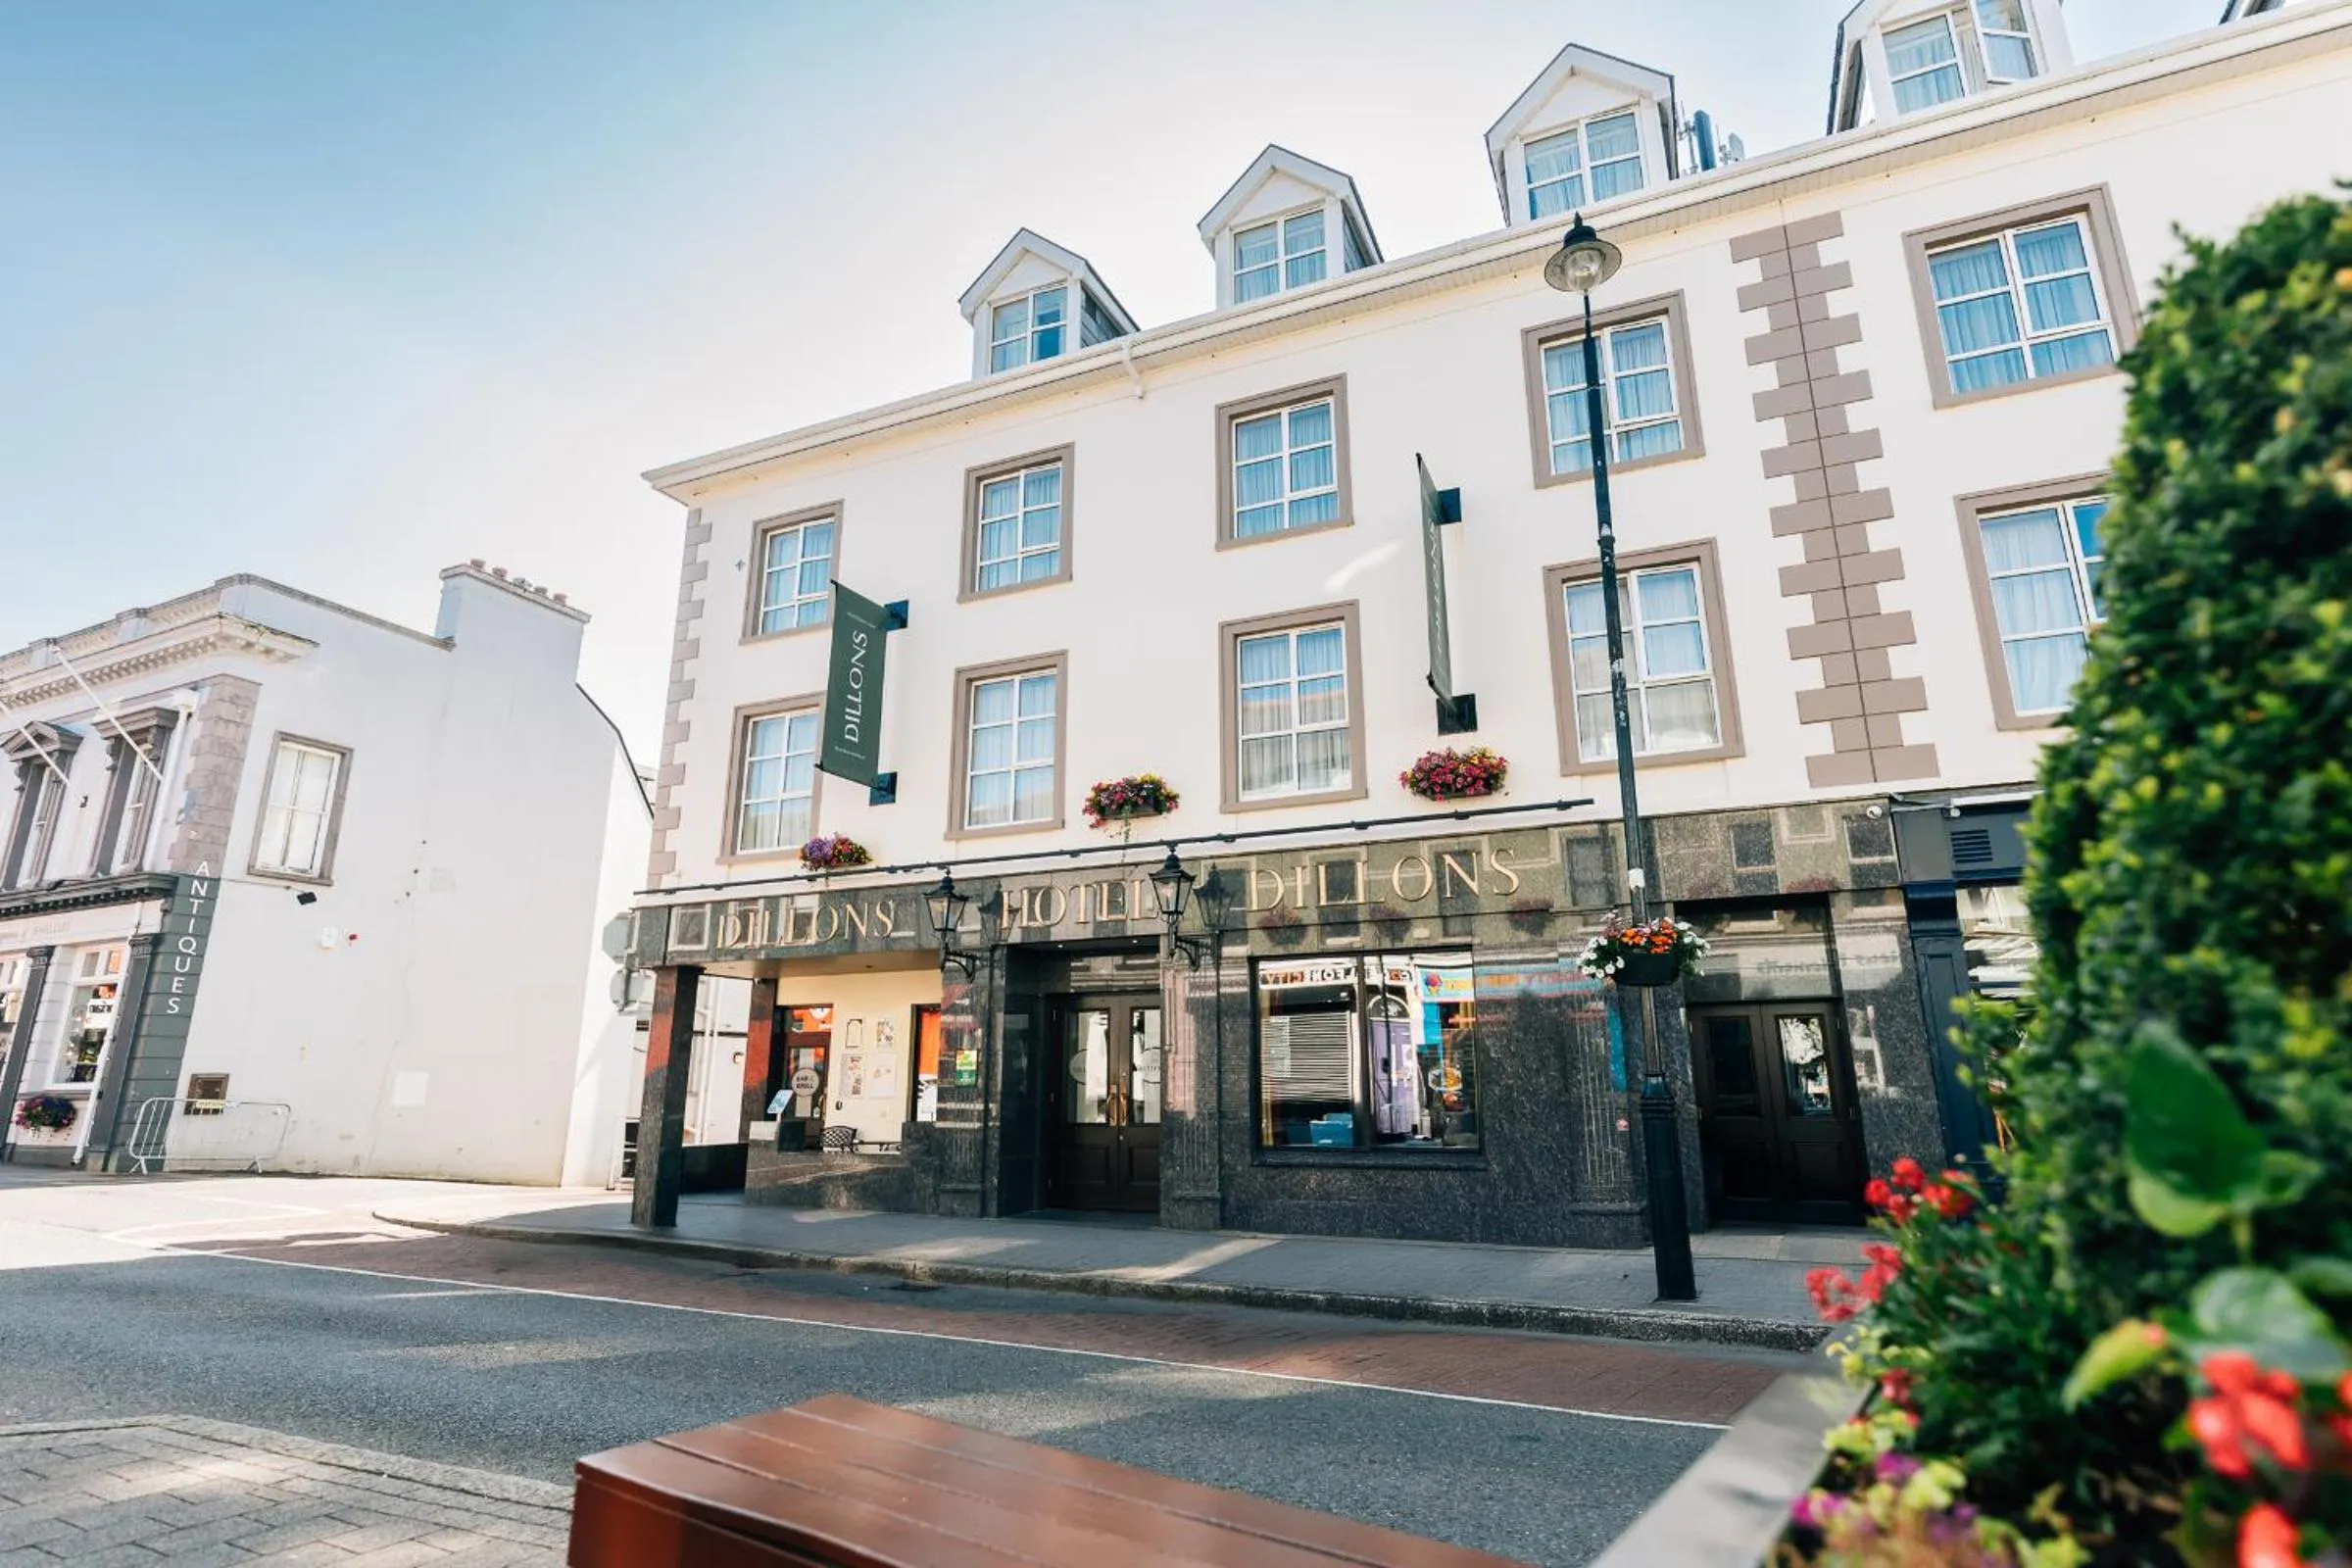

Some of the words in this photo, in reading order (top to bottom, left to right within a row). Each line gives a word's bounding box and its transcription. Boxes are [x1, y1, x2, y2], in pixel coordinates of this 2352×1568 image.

[845, 629, 868, 743] DILLONS
[715, 899, 896, 949] DILLONS
[1000, 879, 1159, 930] HOTEL
[1247, 848, 1520, 911] DILLONS
[167, 860, 210, 1014] ANTIQUES
